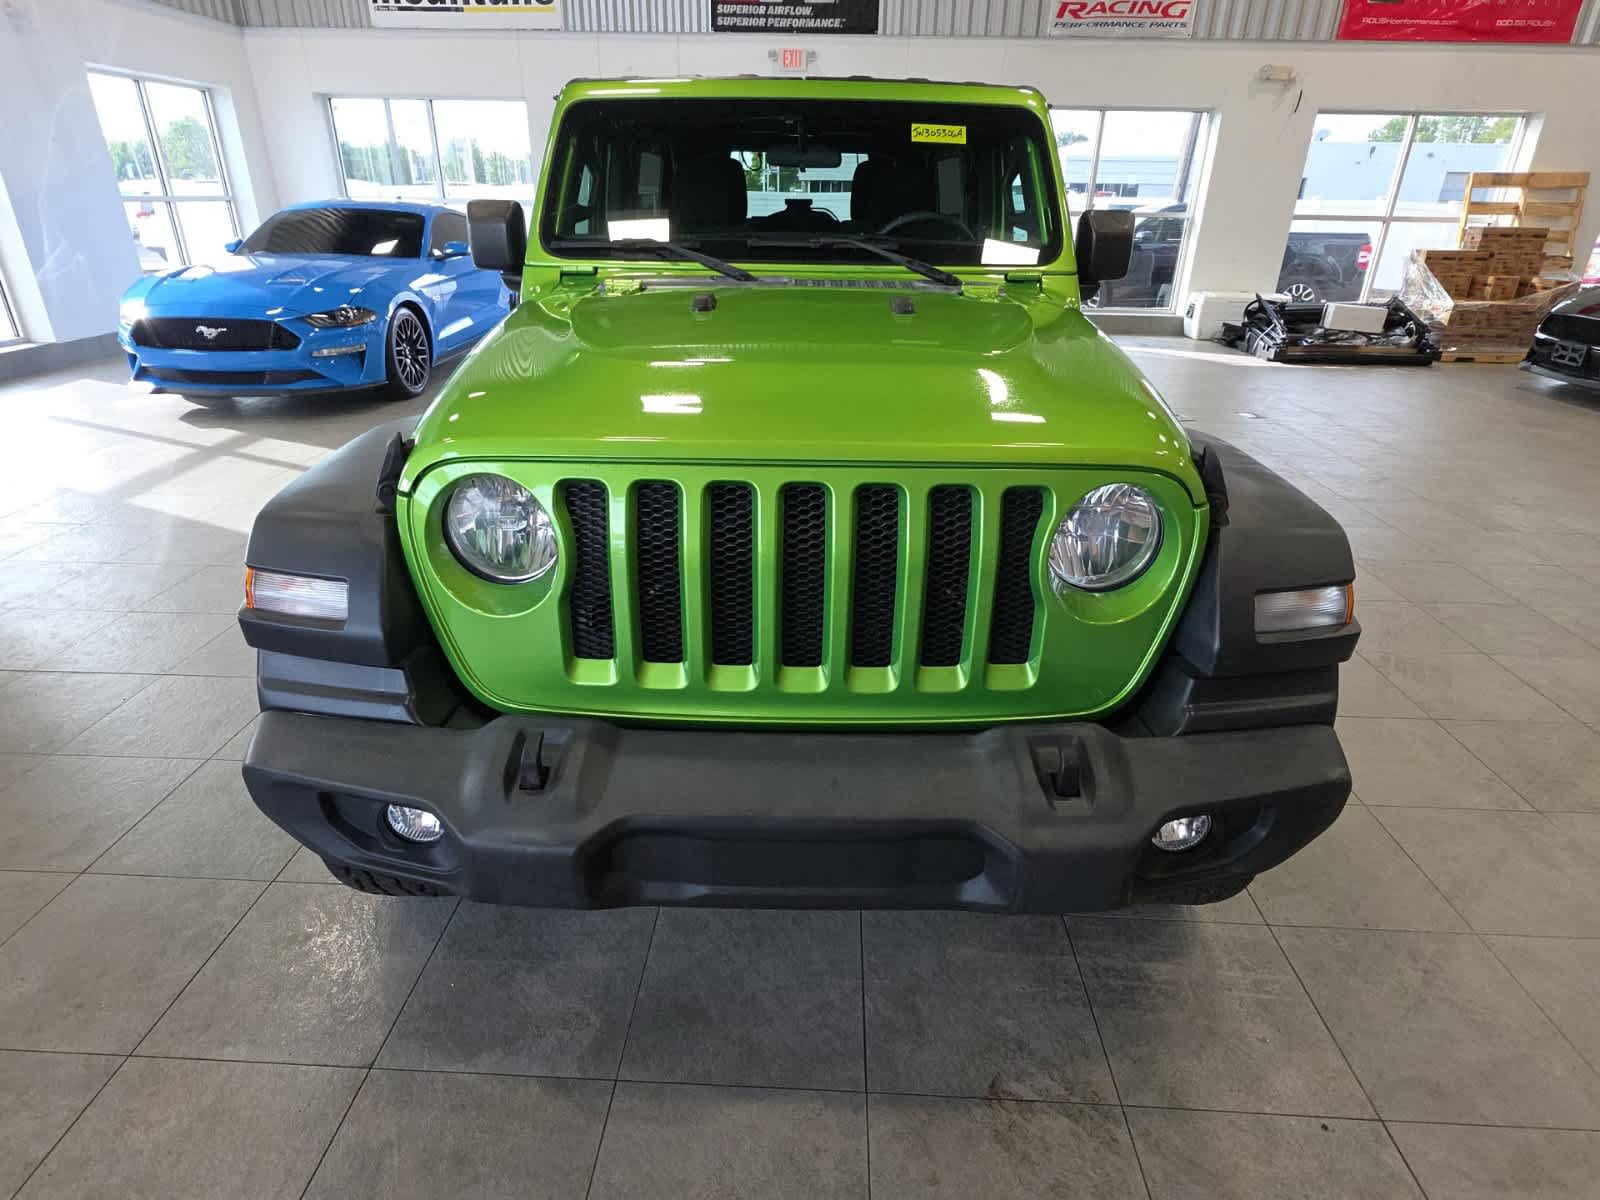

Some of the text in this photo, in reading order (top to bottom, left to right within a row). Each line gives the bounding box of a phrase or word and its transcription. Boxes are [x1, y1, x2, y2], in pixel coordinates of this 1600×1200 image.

[717, 4, 814, 16] SUPERIOR AIRFLOW.
[1056, 0, 1191, 19] RACING
[716, 16, 766, 26] SUPERIOR
[1054, 20, 1188, 29] PERFORMANCE PARTS
[783, 49, 803, 67] EXIT
